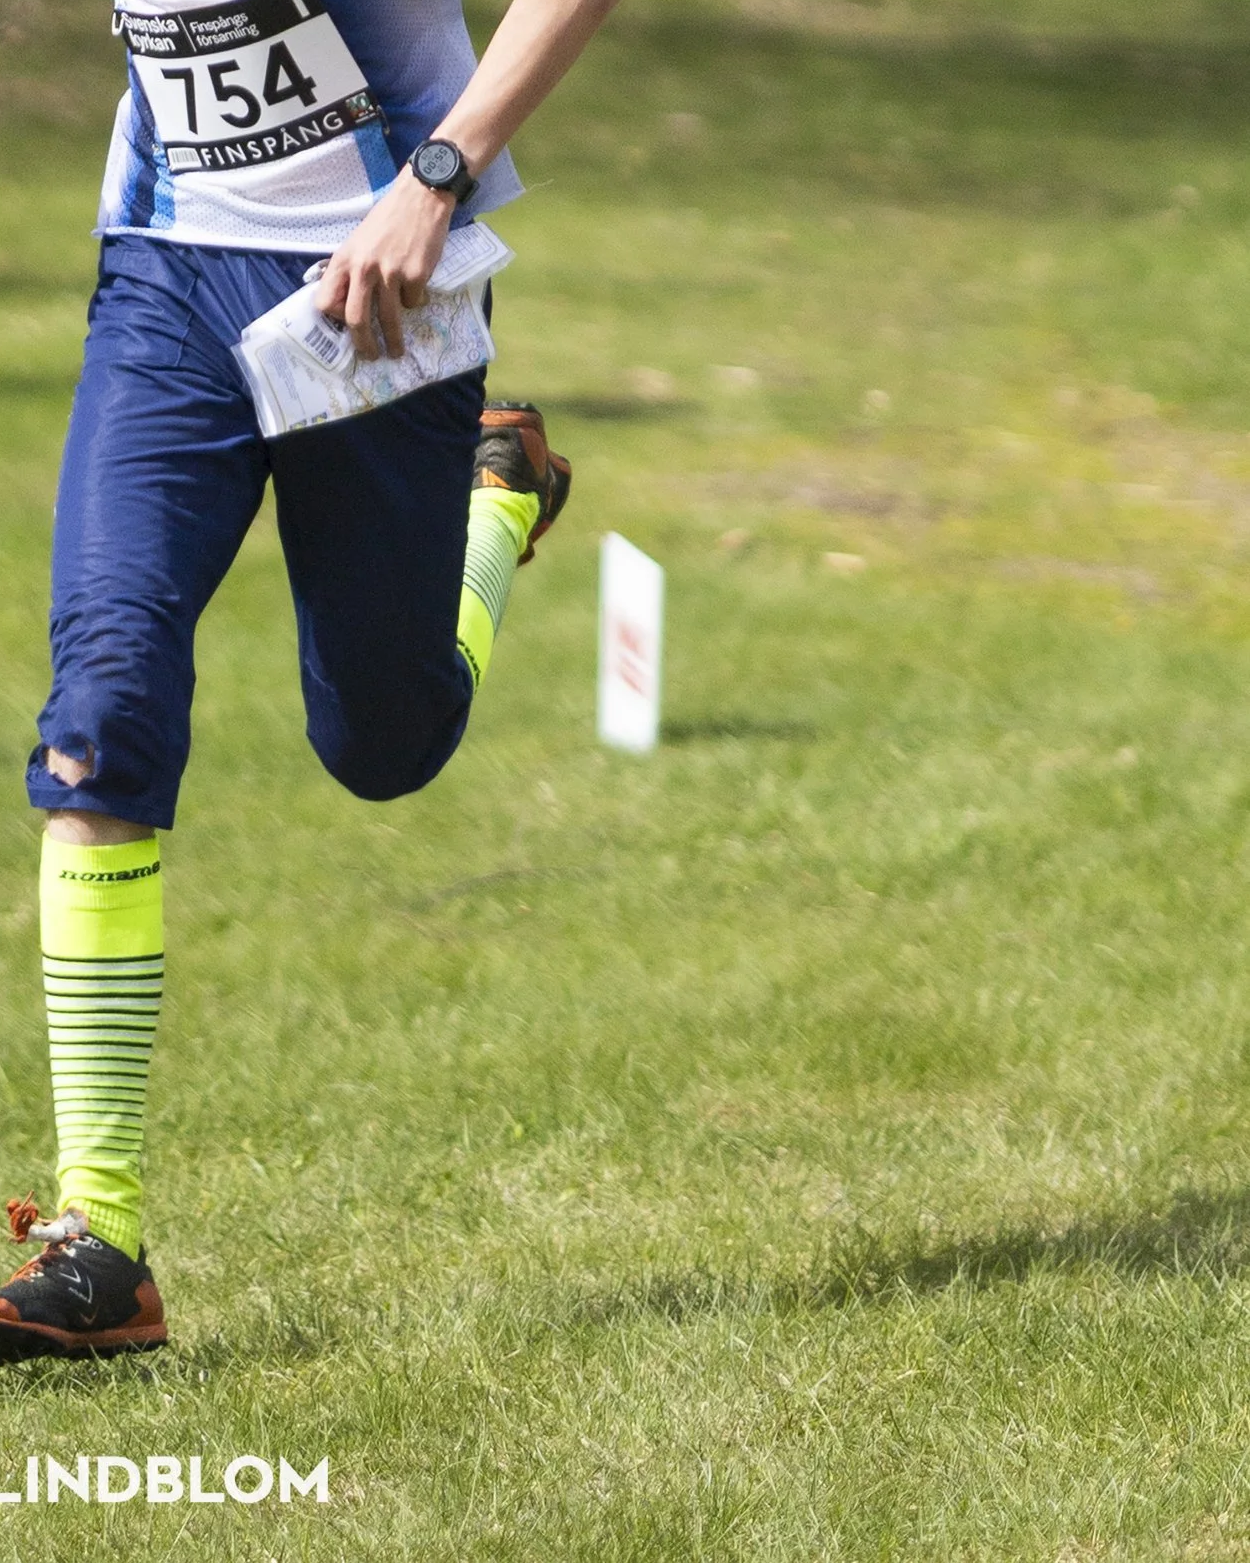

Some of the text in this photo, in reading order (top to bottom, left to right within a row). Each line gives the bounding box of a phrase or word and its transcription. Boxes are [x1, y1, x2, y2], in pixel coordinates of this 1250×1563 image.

[122, 12, 179, 34] Svenska
[189, 12, 249, 34] Finspångs
[128, 30, 177, 53] kyrkan
[195, 24, 260, 47] församling
[160, 40, 318, 136] 754
[200, 111, 344, 167] FINSPÅNG
[59, 860, 161, 882] noname
